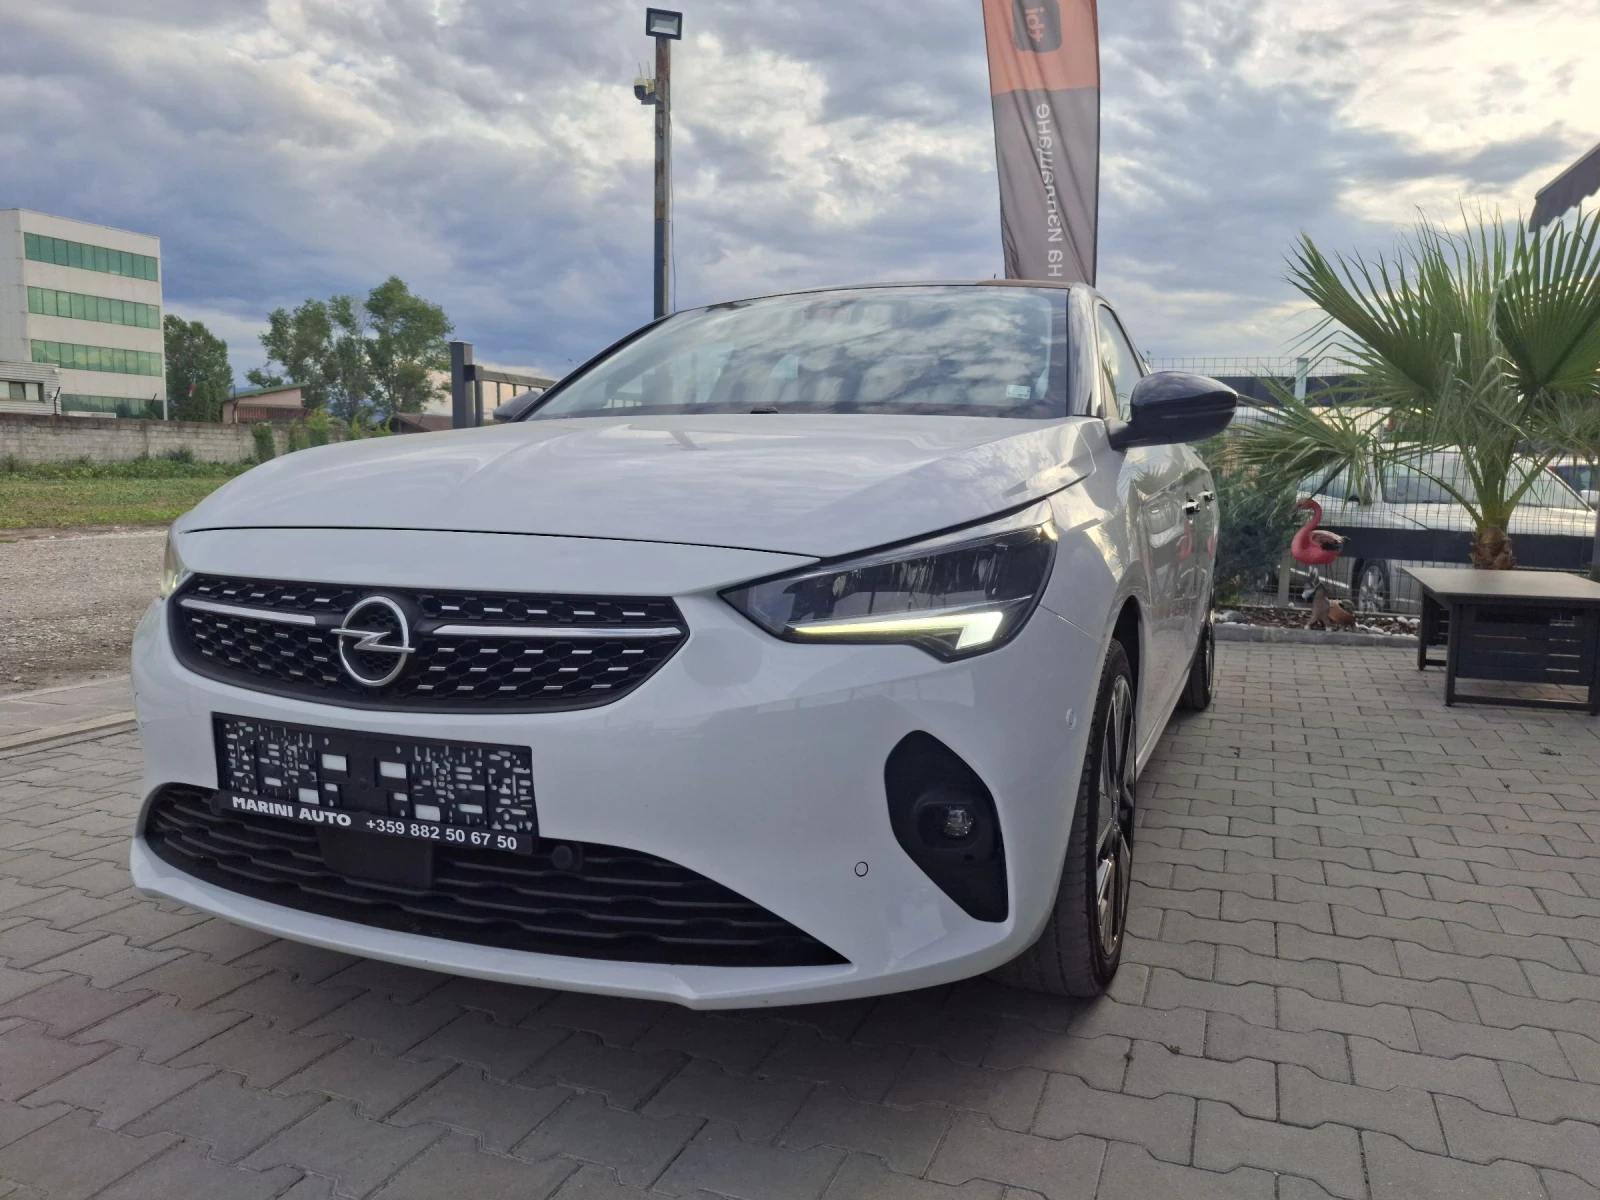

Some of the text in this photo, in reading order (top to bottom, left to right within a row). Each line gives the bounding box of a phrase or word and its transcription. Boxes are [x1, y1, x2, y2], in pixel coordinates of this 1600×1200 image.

[232, 796, 517, 850] MARINI AUTO +359 882 50 67 50
